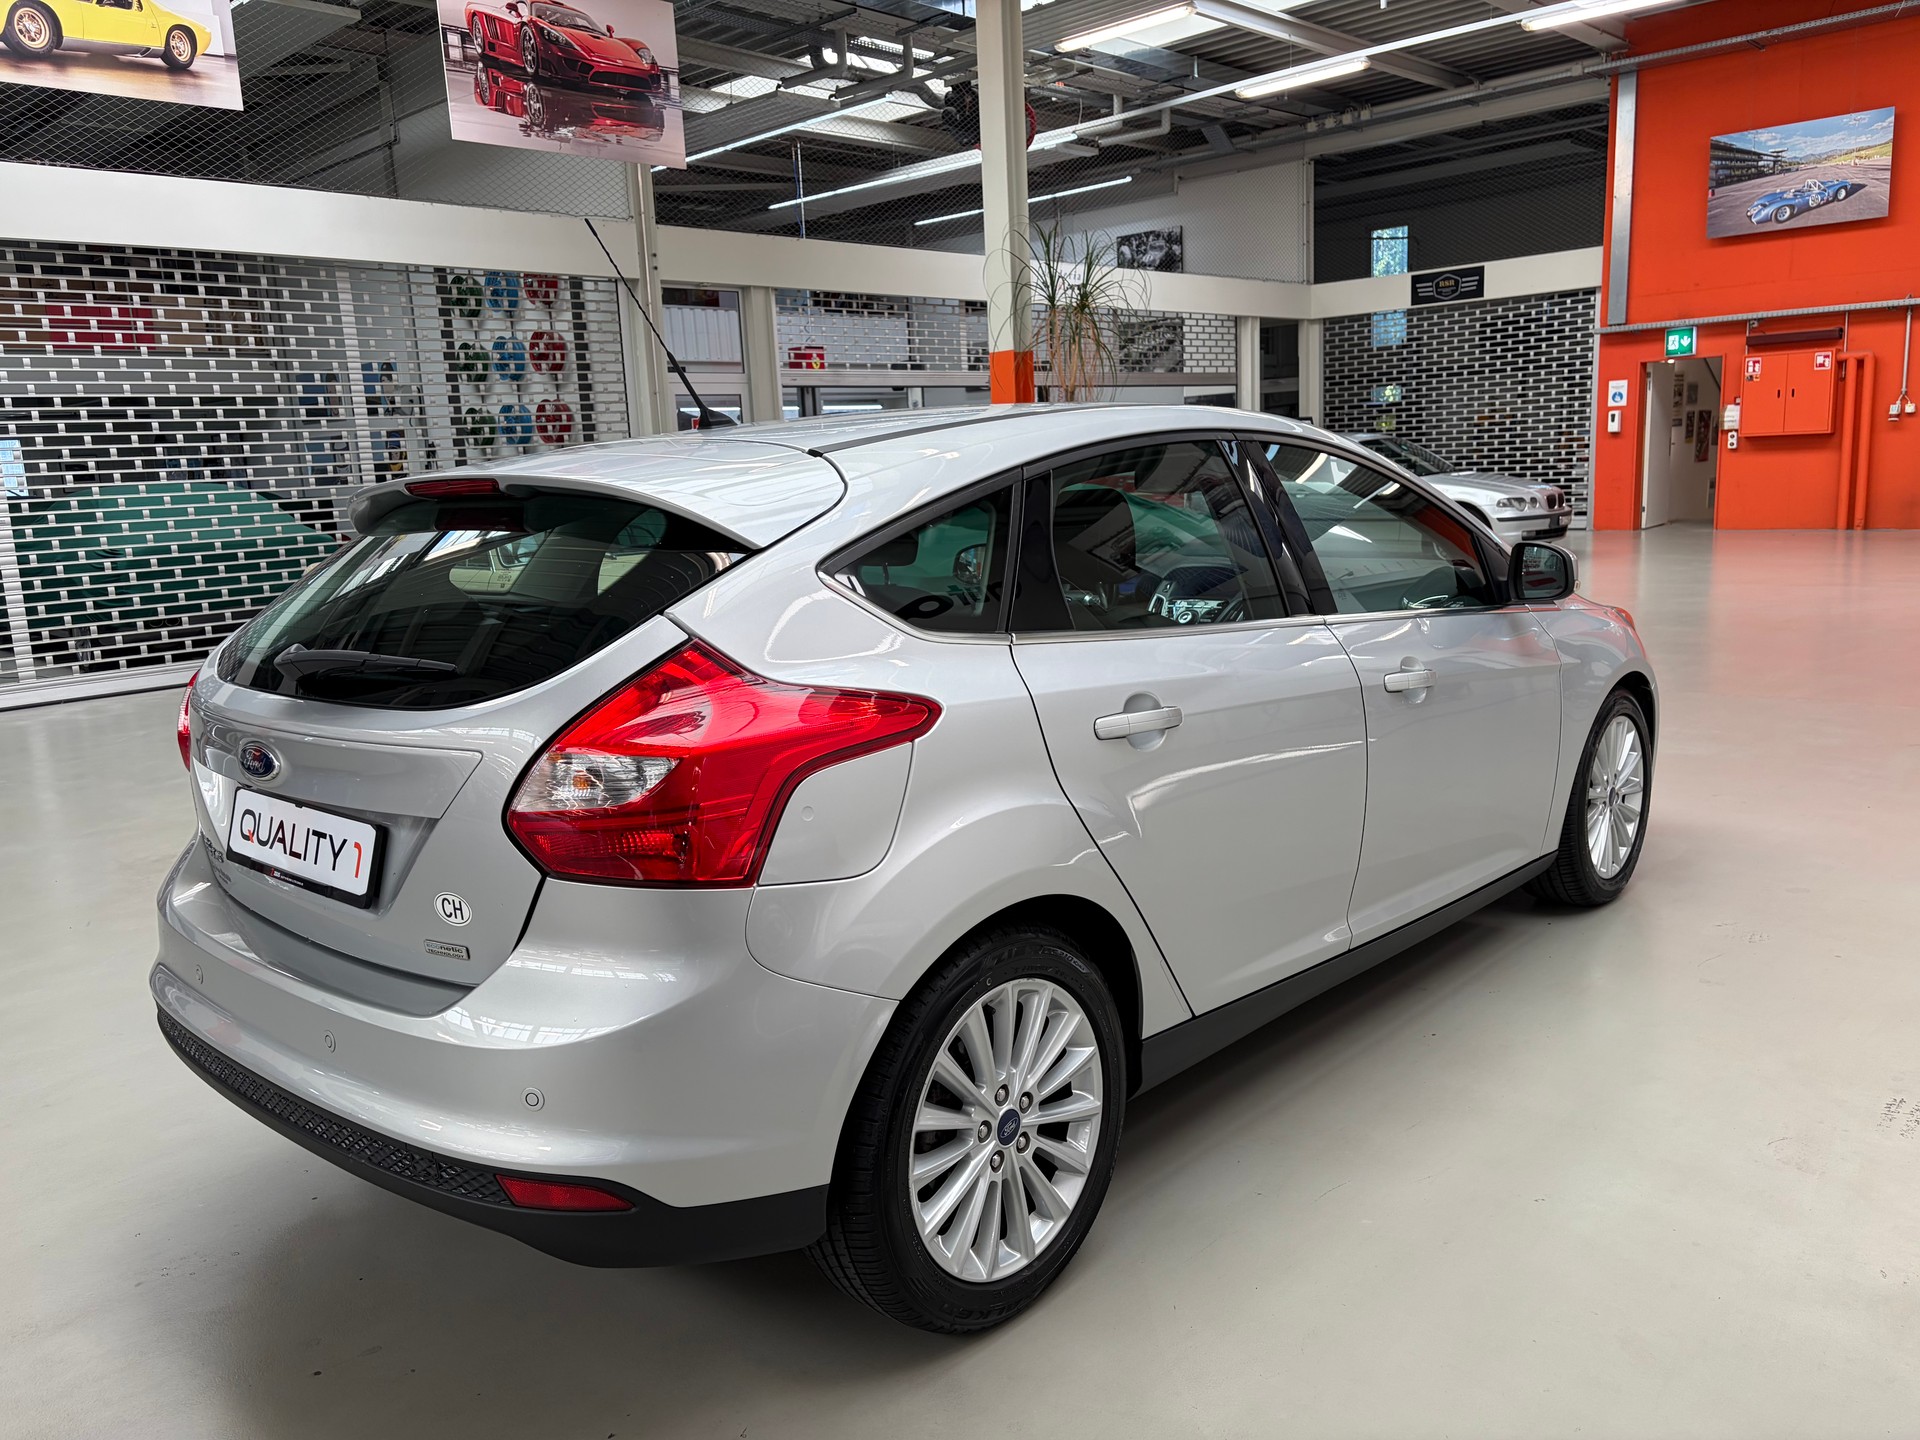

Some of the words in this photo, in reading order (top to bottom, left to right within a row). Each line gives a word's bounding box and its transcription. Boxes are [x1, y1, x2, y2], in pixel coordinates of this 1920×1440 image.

[1439, 279, 1455, 287] RSR
[243, 749, 266, 774] Ford
[240, 808, 348, 871] QUALITY
[353, 841, 363, 879] 1
[441, 897, 465, 922] CH
[427, 948, 465, 959] TECHNOLOGY
